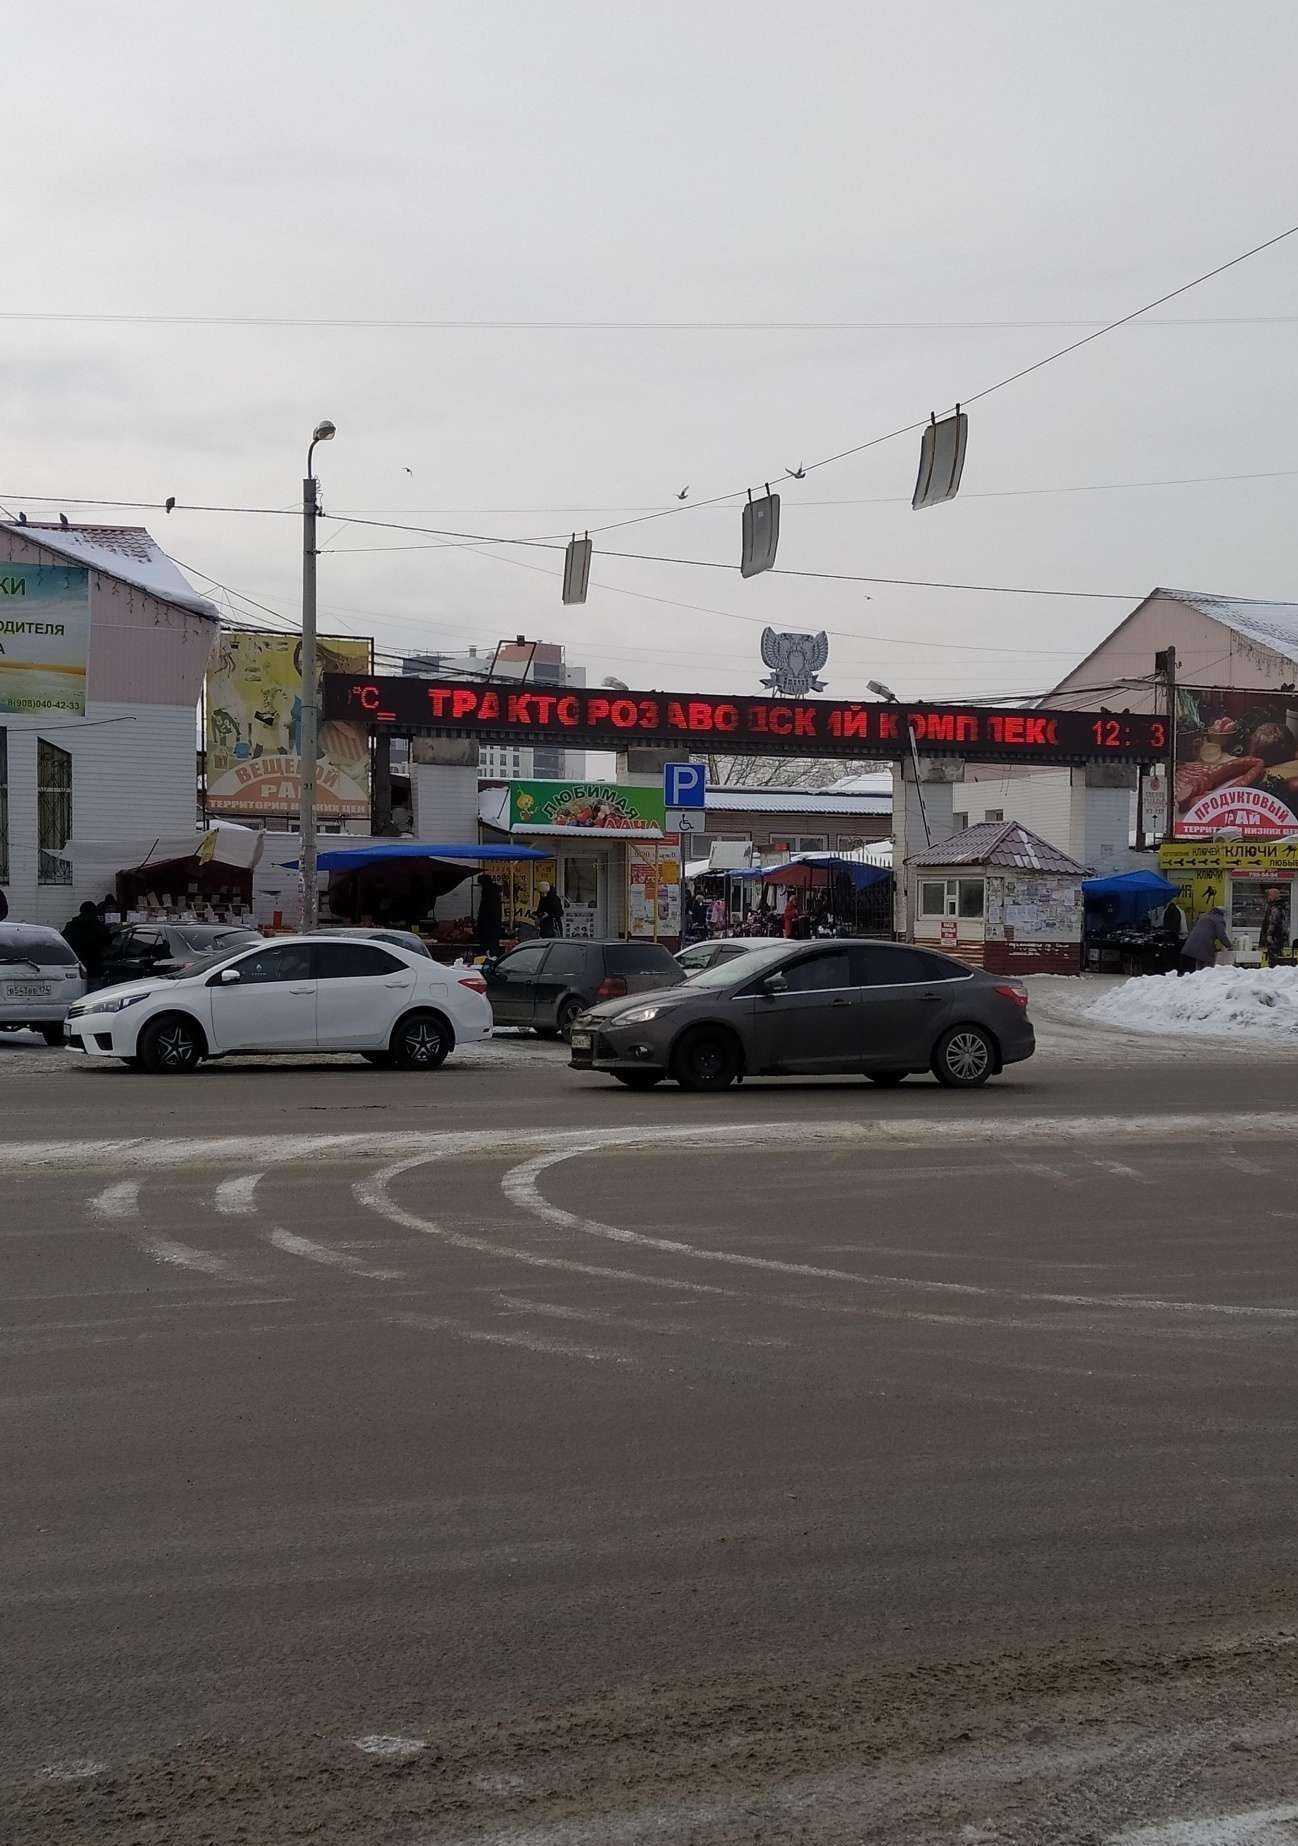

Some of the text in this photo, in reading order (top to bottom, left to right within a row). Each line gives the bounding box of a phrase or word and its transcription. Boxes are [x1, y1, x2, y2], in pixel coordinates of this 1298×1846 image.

[235, 758, 339, 788] ВЕЩЕОЙ
[261, 781, 300, 798] РА
[542, 784, 640, 820] ЛЮБИМАЯ
[1194, 791, 1290, 823] ПРОДУКТОВЫЙ
[1224, 845, 1278, 858] КЛЮЧИ
